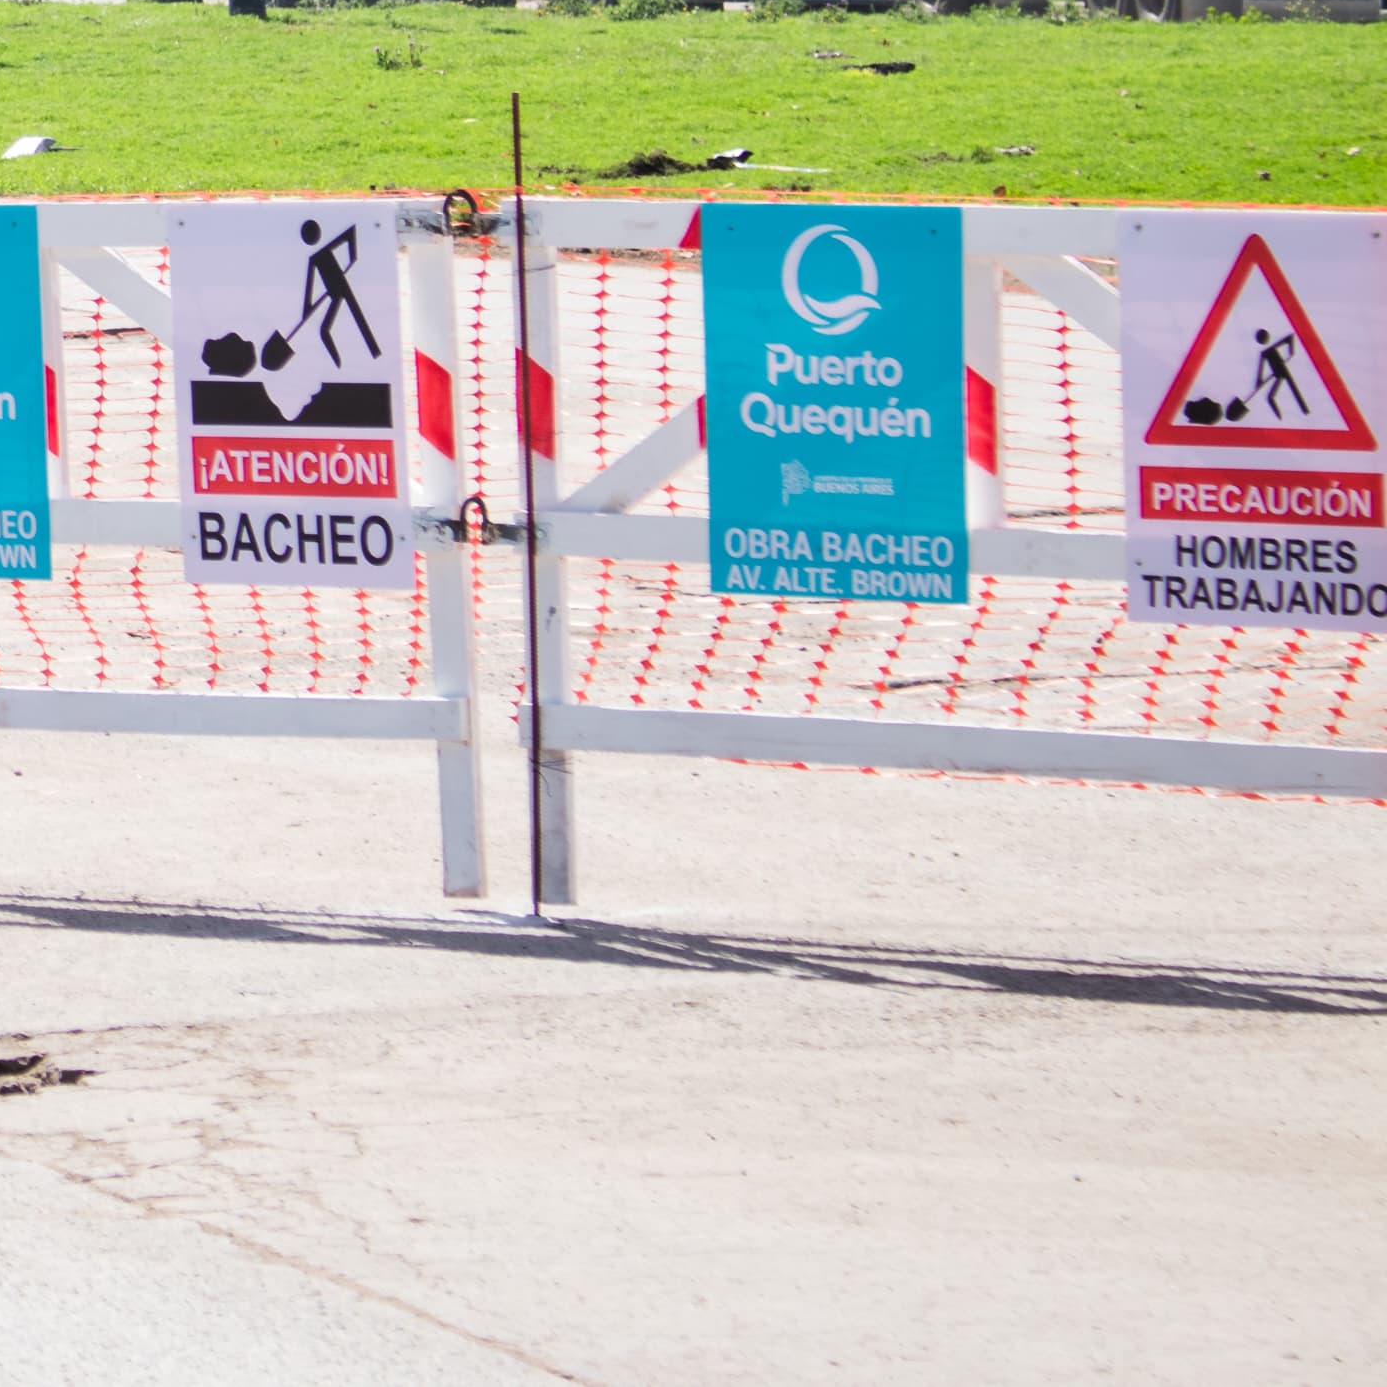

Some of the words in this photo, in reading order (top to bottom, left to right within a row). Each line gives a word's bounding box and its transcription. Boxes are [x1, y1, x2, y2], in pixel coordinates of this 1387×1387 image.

[764, 343, 903, 387] Puerto
[740, 391, 932, 444] Quequén
[199, 443, 389, 490] ¡ATENCIÓN!
[1152, 481, 1372, 518] PRECAUCIÓN
[199, 512, 393, 566] BACHEO
[724, 527, 813, 561] OBRA
[821, 532, 954, 568] BACHEO
[1175, 534, 1358, 574] HOMBRES
[727, 564, 765, 590] AV.
[773, 567, 843, 594] ALTE.
[851, 570, 953, 599] BROWN
[1142, 575, 1387, 618] TRABAJANDO
